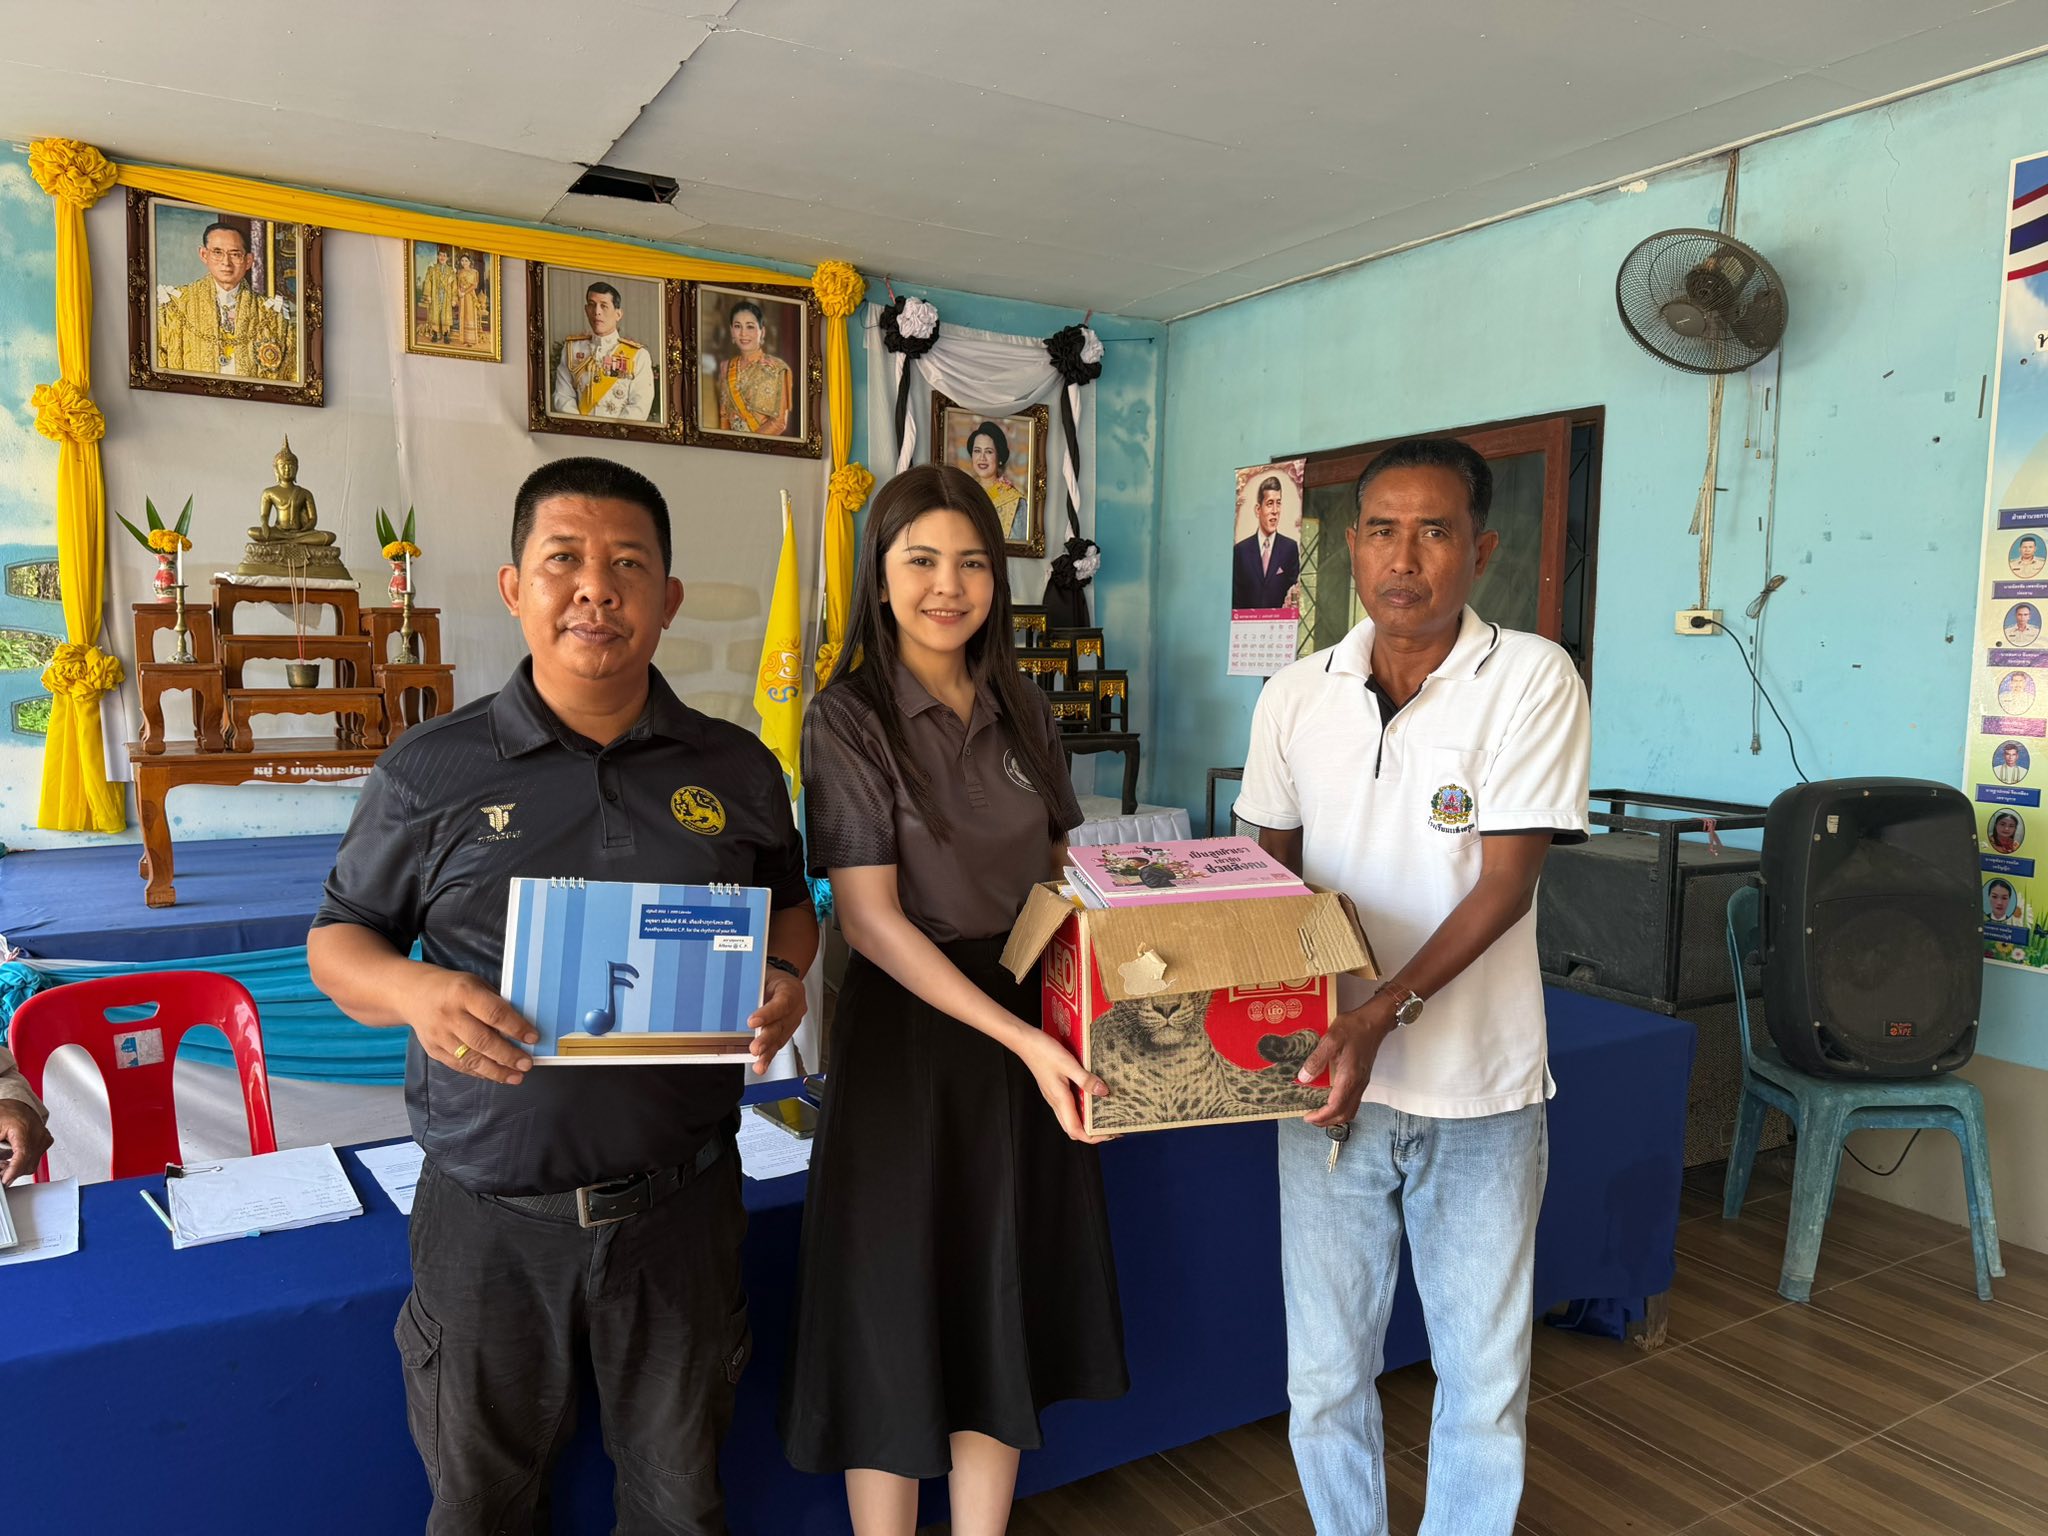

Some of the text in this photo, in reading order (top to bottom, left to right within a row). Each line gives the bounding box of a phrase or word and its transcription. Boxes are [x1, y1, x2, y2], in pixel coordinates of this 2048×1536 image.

[253, 762, 273, 777] หมู่
[277, 766, 287, 775] 3
[1268, 1008, 1283, 1016] LEO
